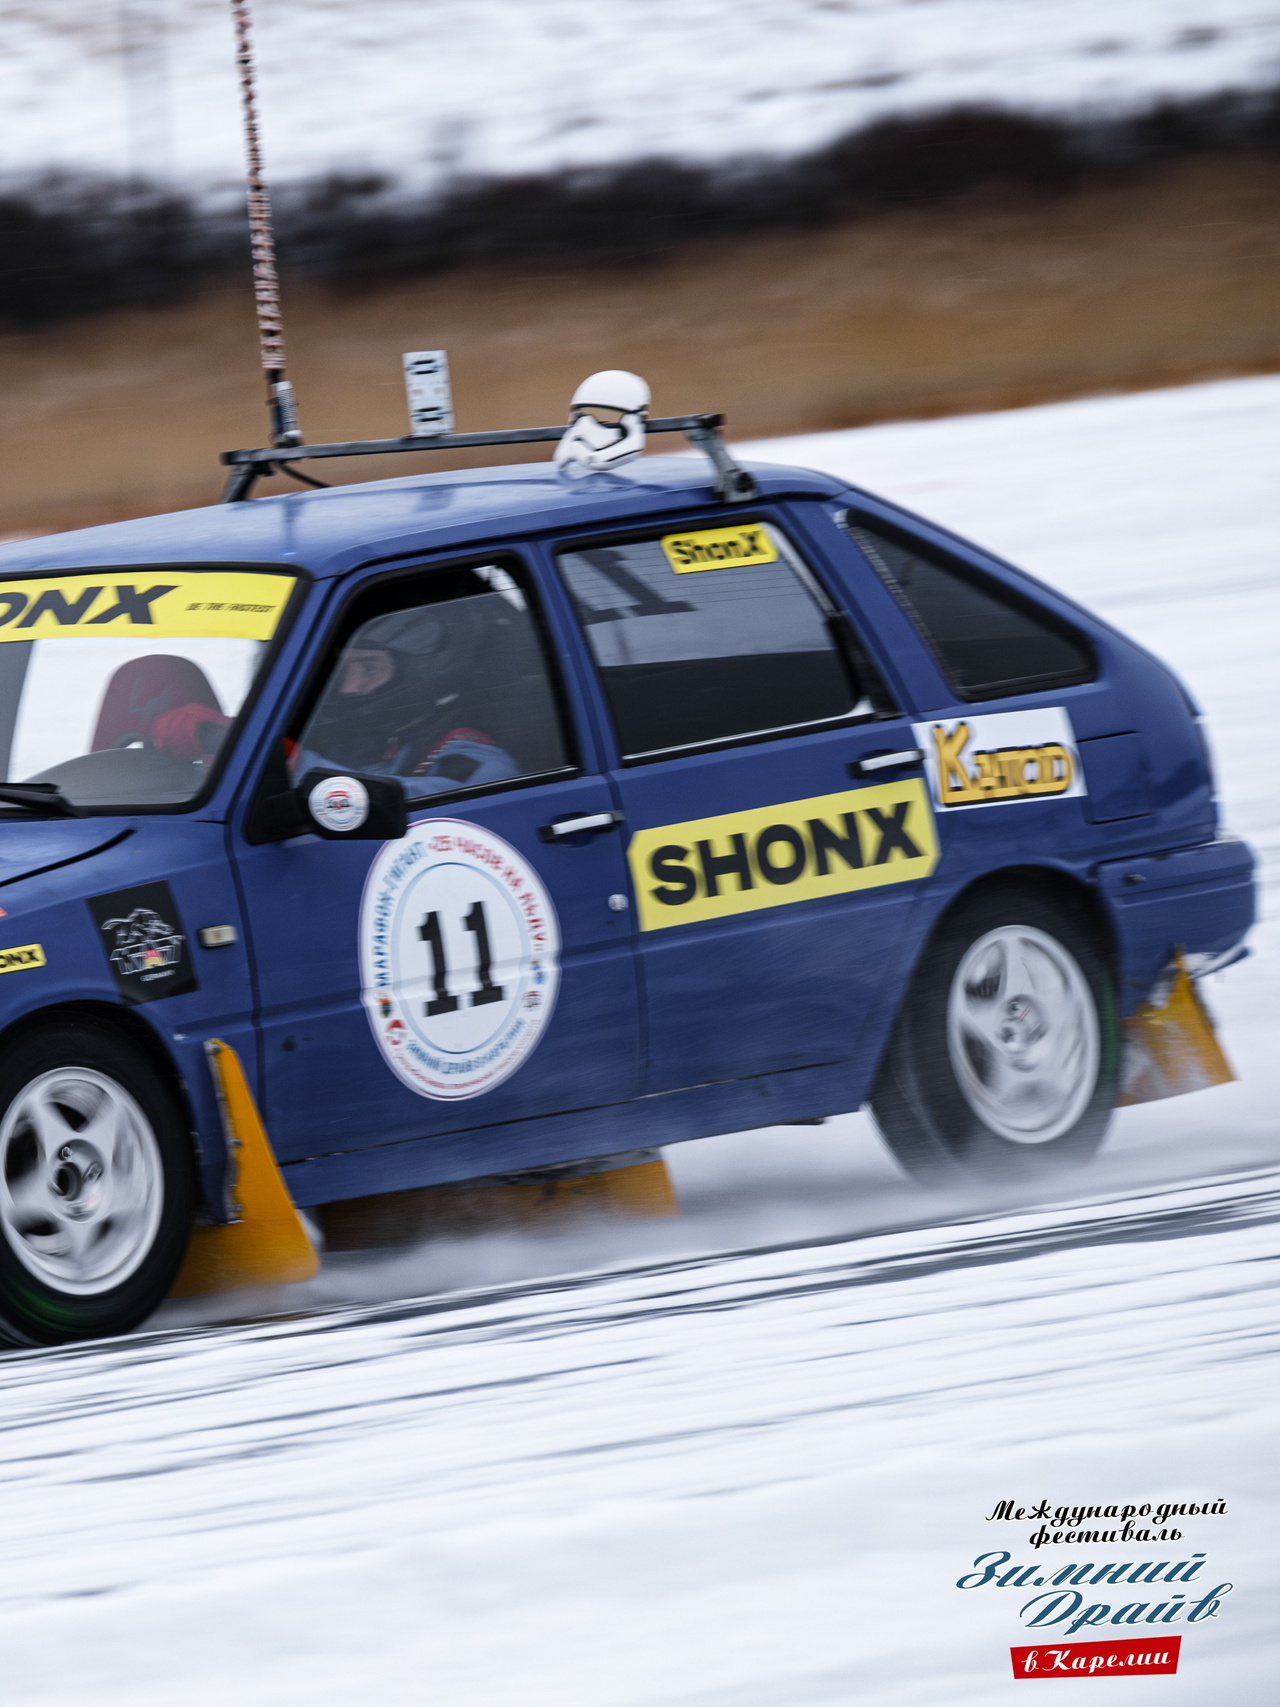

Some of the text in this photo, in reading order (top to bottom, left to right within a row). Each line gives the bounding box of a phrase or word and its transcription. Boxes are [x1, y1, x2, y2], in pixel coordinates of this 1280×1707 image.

[671, 530, 762, 566] ShonX
[648, 800, 928, 906] SHONX
[416, 900, 507, 1017] 11
